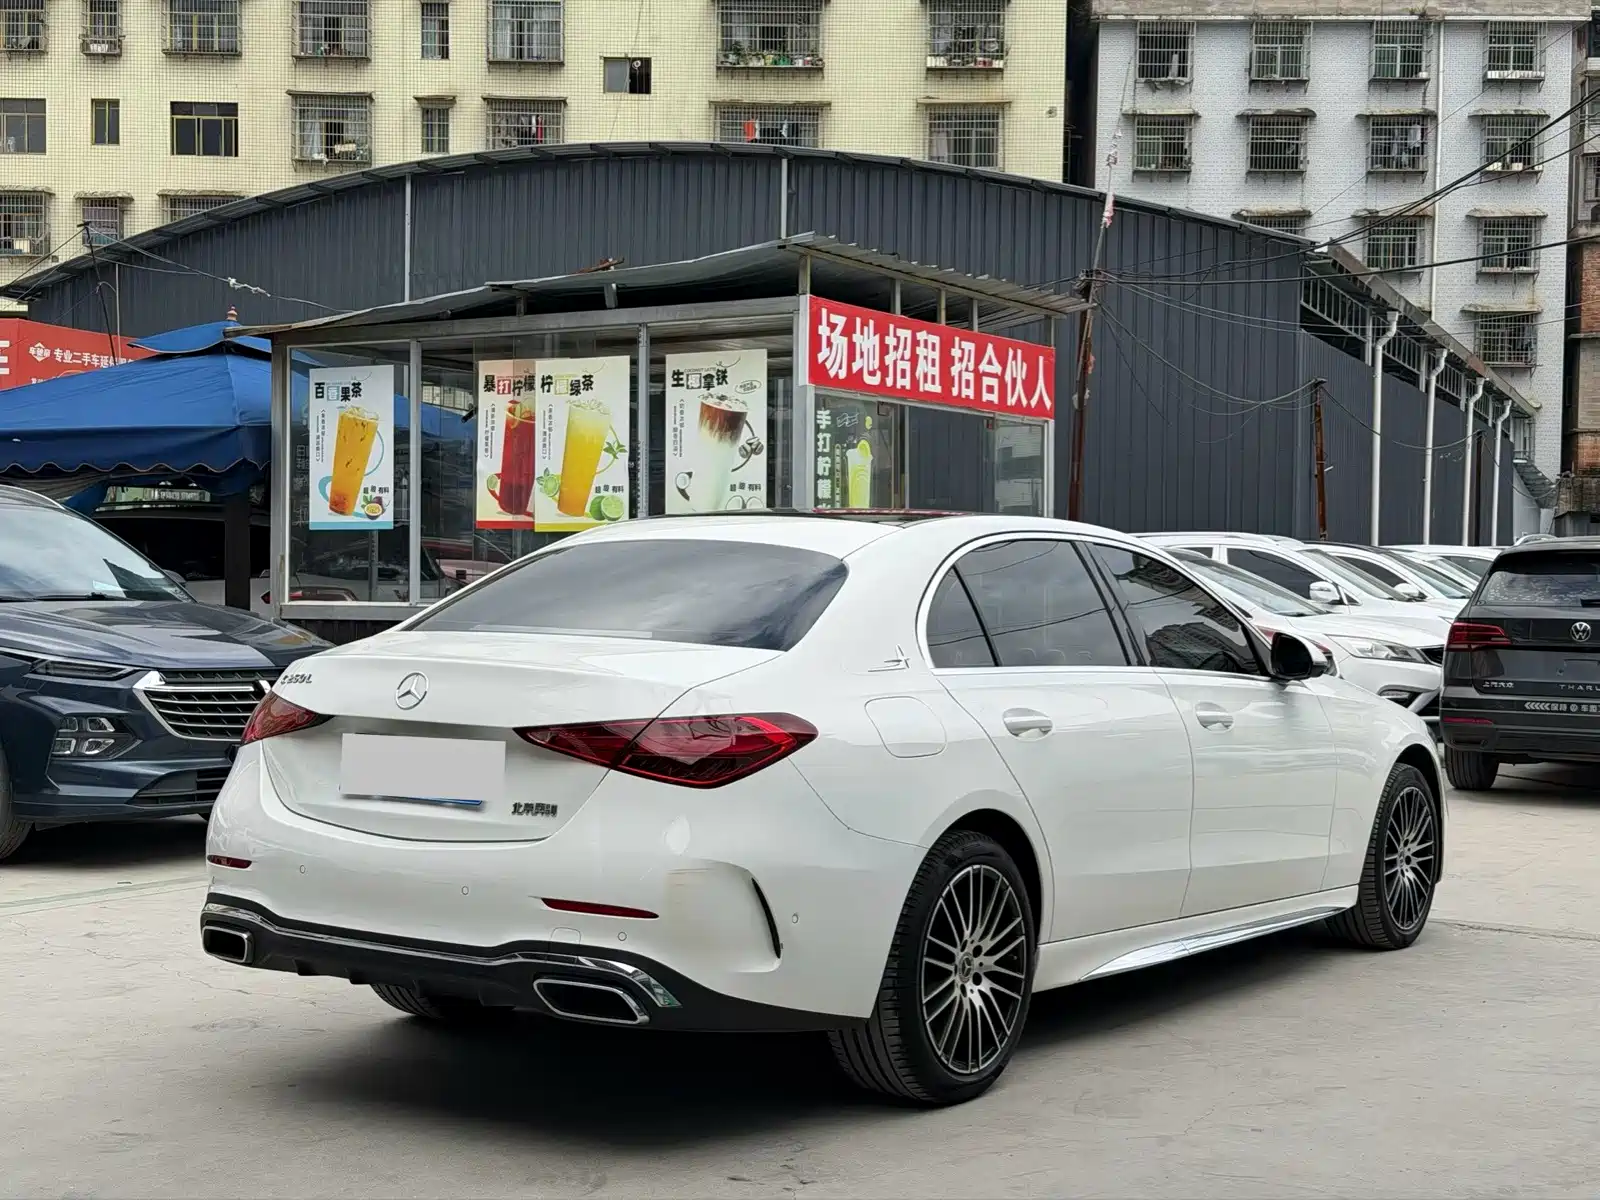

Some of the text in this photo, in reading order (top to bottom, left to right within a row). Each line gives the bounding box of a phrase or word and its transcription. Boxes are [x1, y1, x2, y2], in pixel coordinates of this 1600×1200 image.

[817, 307, 1052, 411] 场地招租 招合伙人
